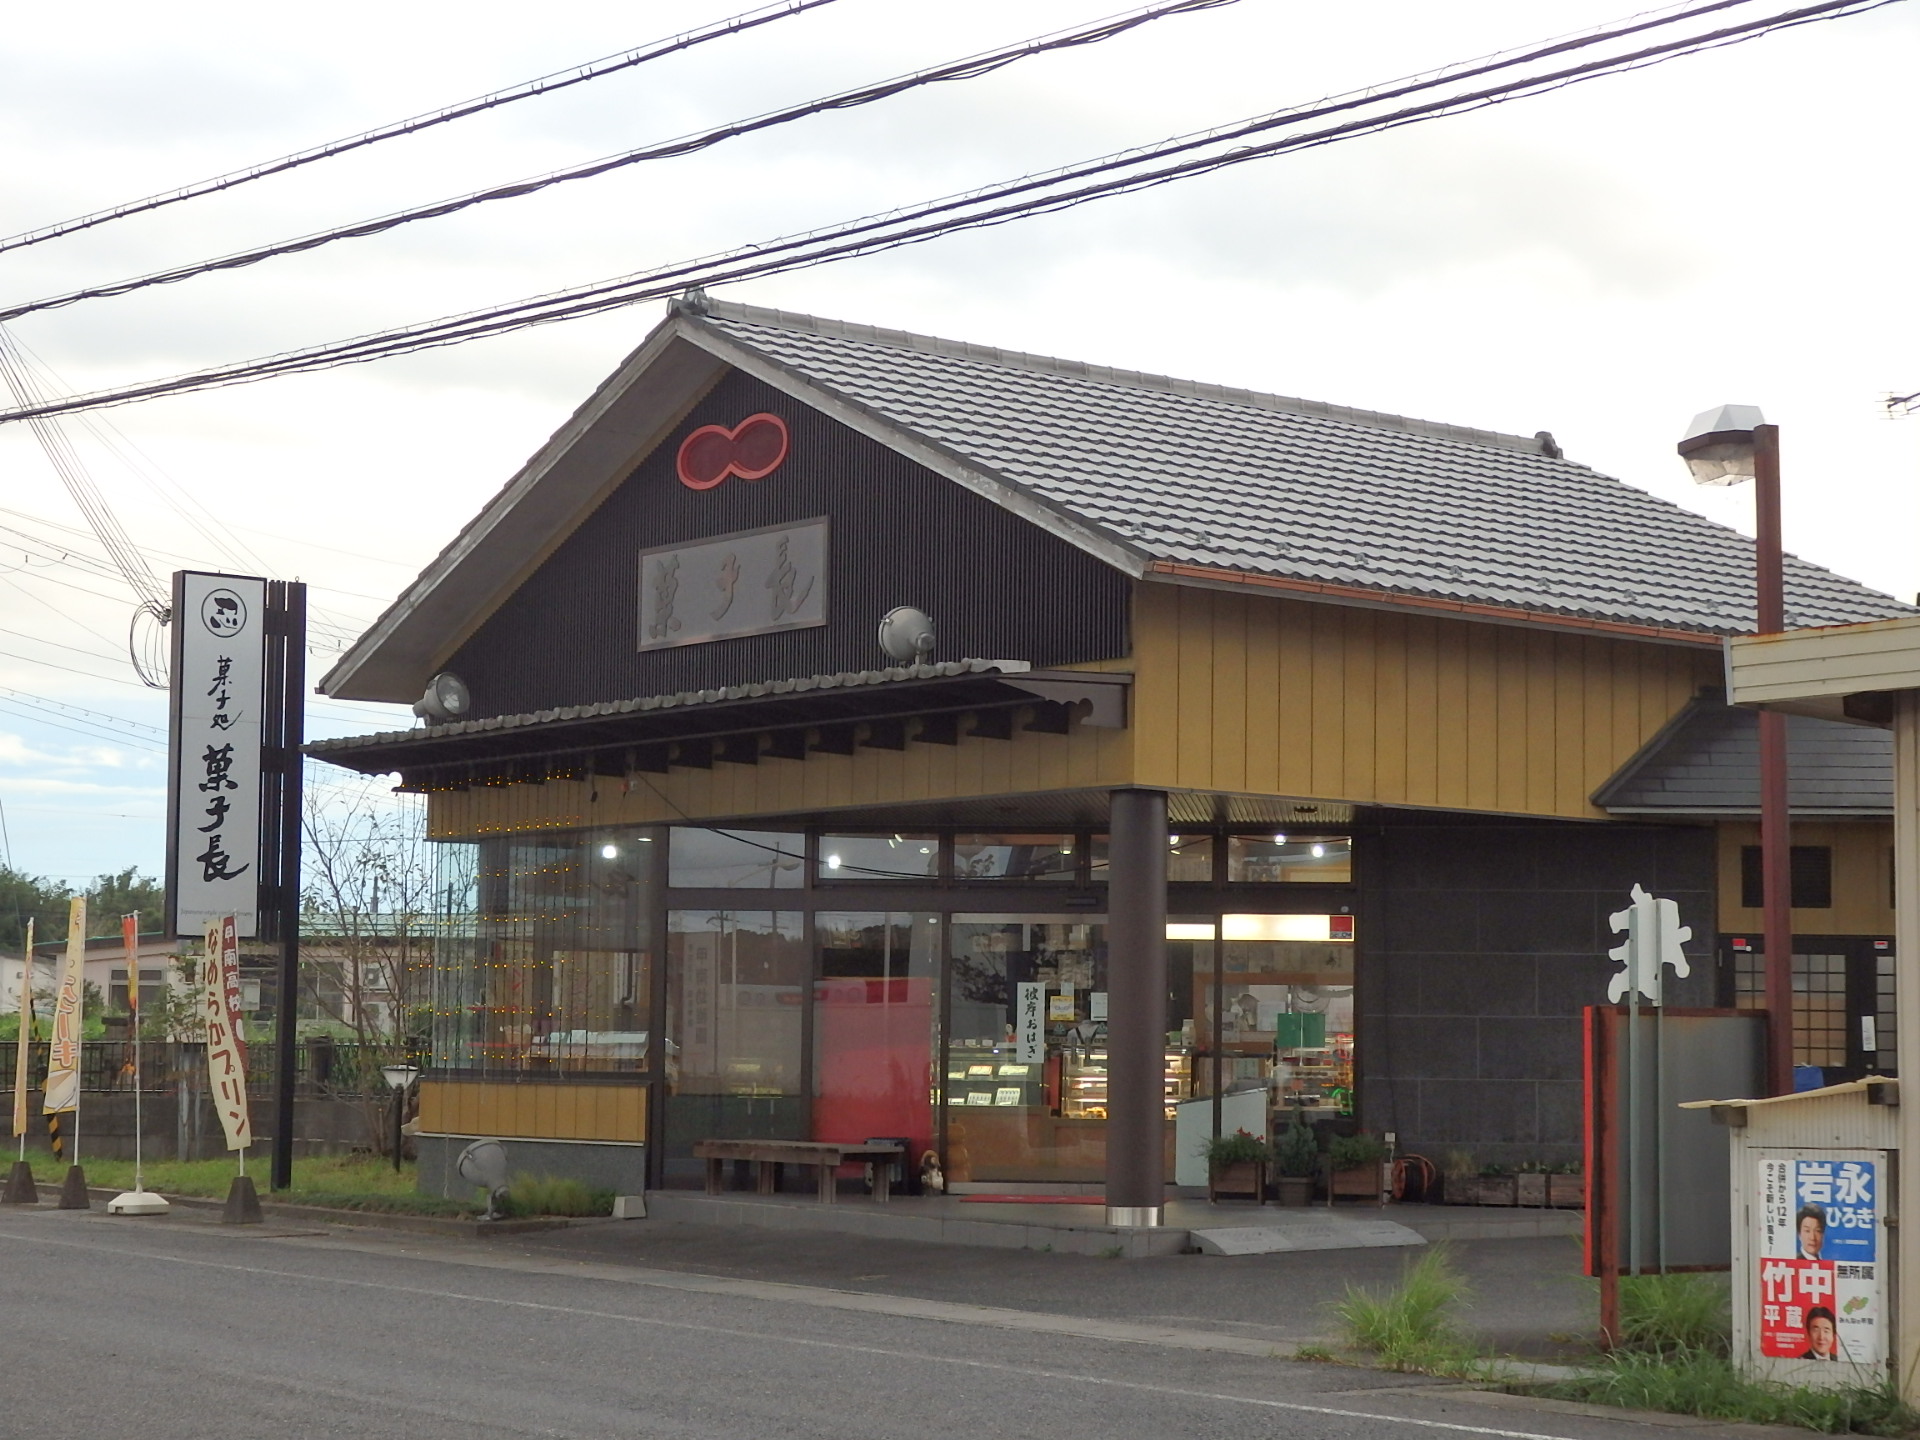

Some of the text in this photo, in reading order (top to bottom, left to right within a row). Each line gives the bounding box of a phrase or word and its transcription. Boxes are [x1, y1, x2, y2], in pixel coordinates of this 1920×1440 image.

[207, 655, 243, 731] 菓子処
[197, 742, 250, 882] 菓子長
[207, 927, 245, 1137] なめらかプリン
[1024, 986, 1039, 1059] 彼岸おはぎ
[1797, 1162, 1873, 1204] 岩永
[1825, 1206, 1874, 1229] ひろき
[1762, 1260, 1833, 1304] 竹中
[1837, 1265, 1875, 1280] 無所属
[1764, 1304, 1804, 1328] 平蔵
